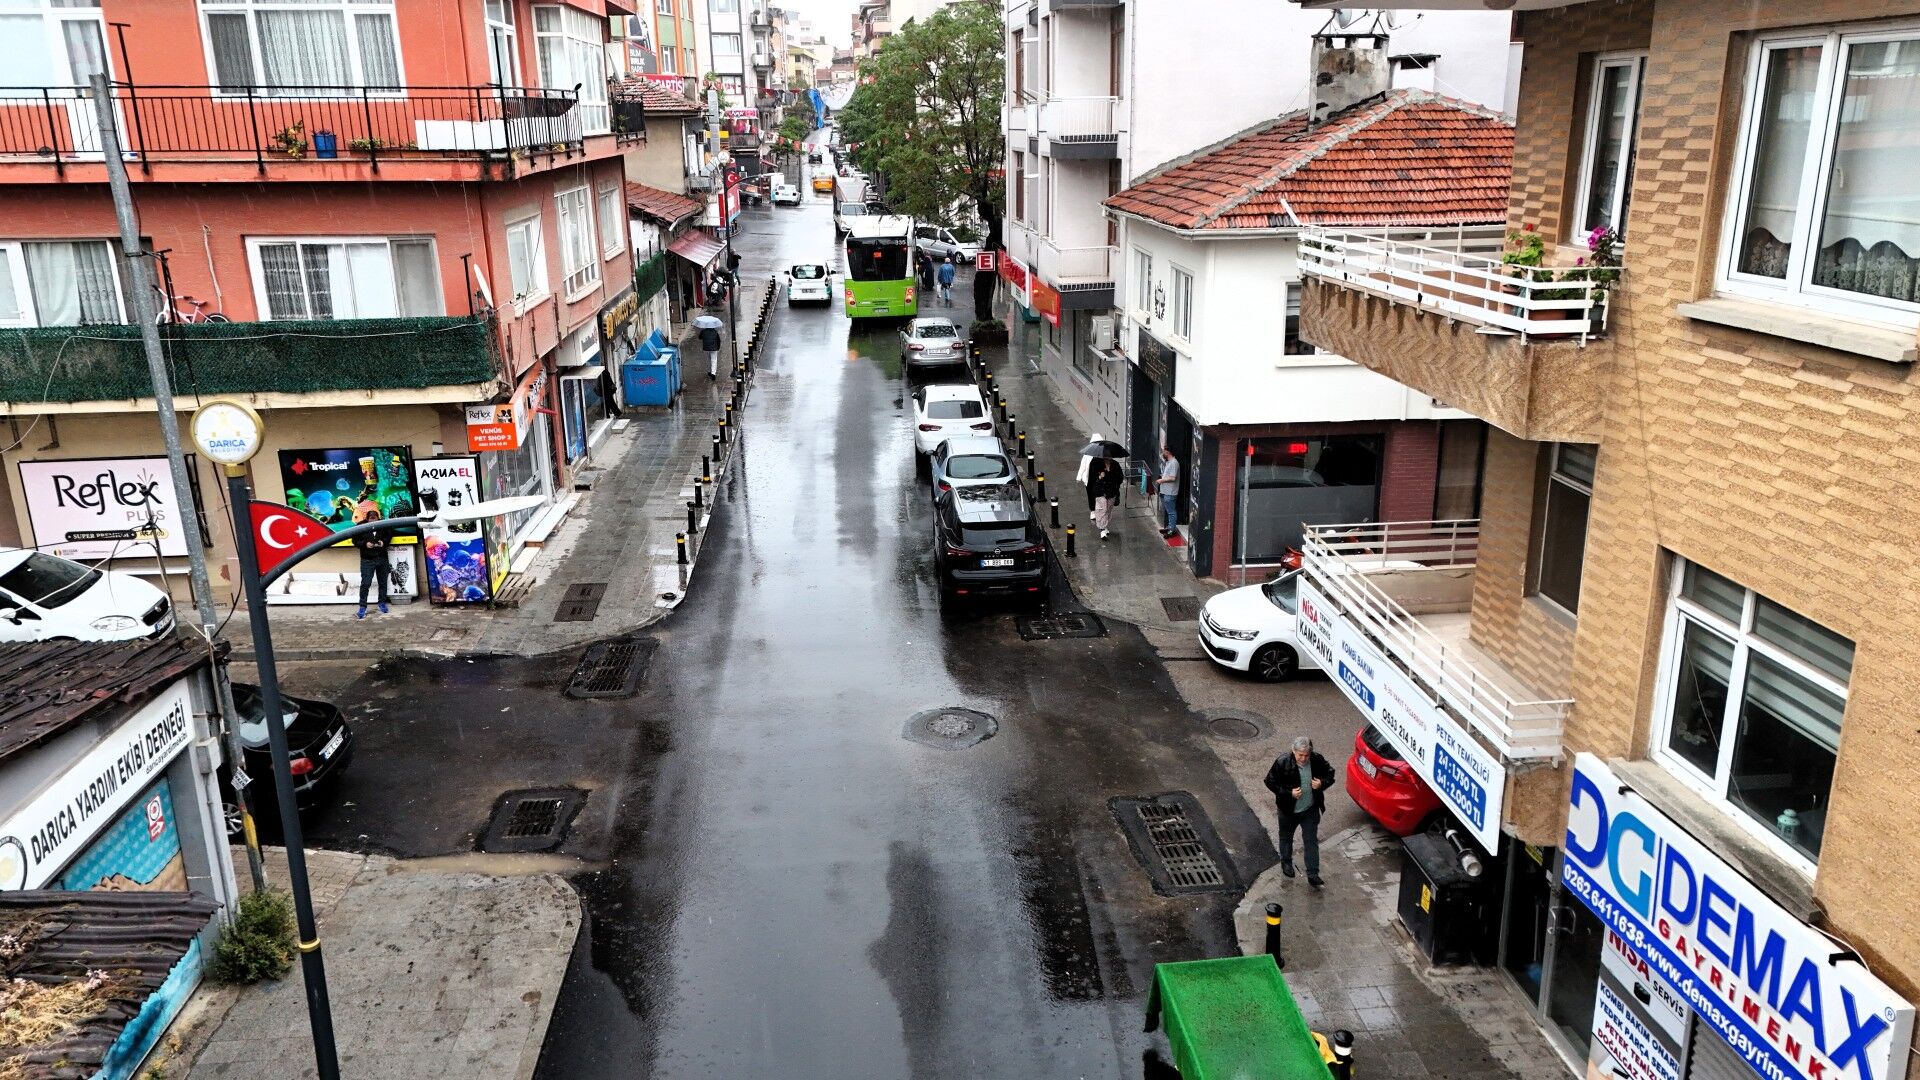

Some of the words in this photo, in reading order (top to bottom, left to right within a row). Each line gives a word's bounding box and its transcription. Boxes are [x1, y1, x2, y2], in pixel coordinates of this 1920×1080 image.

[980, 255, 991, 268] E
[209, 440, 245, 448] DARICA
[309, 461, 348, 472] Tropical
[51, 469, 163, 515] Reflex
[1302, 597, 1319, 627] NİSA
[1299, 619, 1333, 667] KAMPANYA
[1341, 639, 1357, 661] KOMBİ
[1361, 687, 1370, 704] TL
[1382, 708, 1398, 732] 0533
[1398, 721, 1409, 745] 214
[1410, 735, 1417, 752] 18
[1417, 744, 1425, 761] 41
[1436, 723, 1455, 752] PETEK
[1457, 743, 1490, 784] TEMİZLİĞİ
[30, 804, 77, 865] DARICA
[75, 765, 118, 822] YARDIM
[117, 733, 146, 786] EKİBİ
[145, 697, 186, 759] DERNEĞİ
[1471, 781, 1479, 803] TL
[1473, 805, 1482, 828] TL
[1564, 863, 1590, 900] 0262
[1661, 842, 1890, 1080] DEMAX
[1600, 982, 1625, 1014] KOMBİ
[1625, 1008, 1650, 1043] BAKIM
[1652, 980, 1685, 1018] SERVİS
[1659, 917, 1838, 1080] GAYRİMENK
[1600, 999, 1623, 1031] YEDEK
[1624, 1026, 1649, 1060] PARÇA
[1605, 1020, 1629, 1053] PETEK
[1597, 1027, 1639, 1080] DOĞALGAZ
